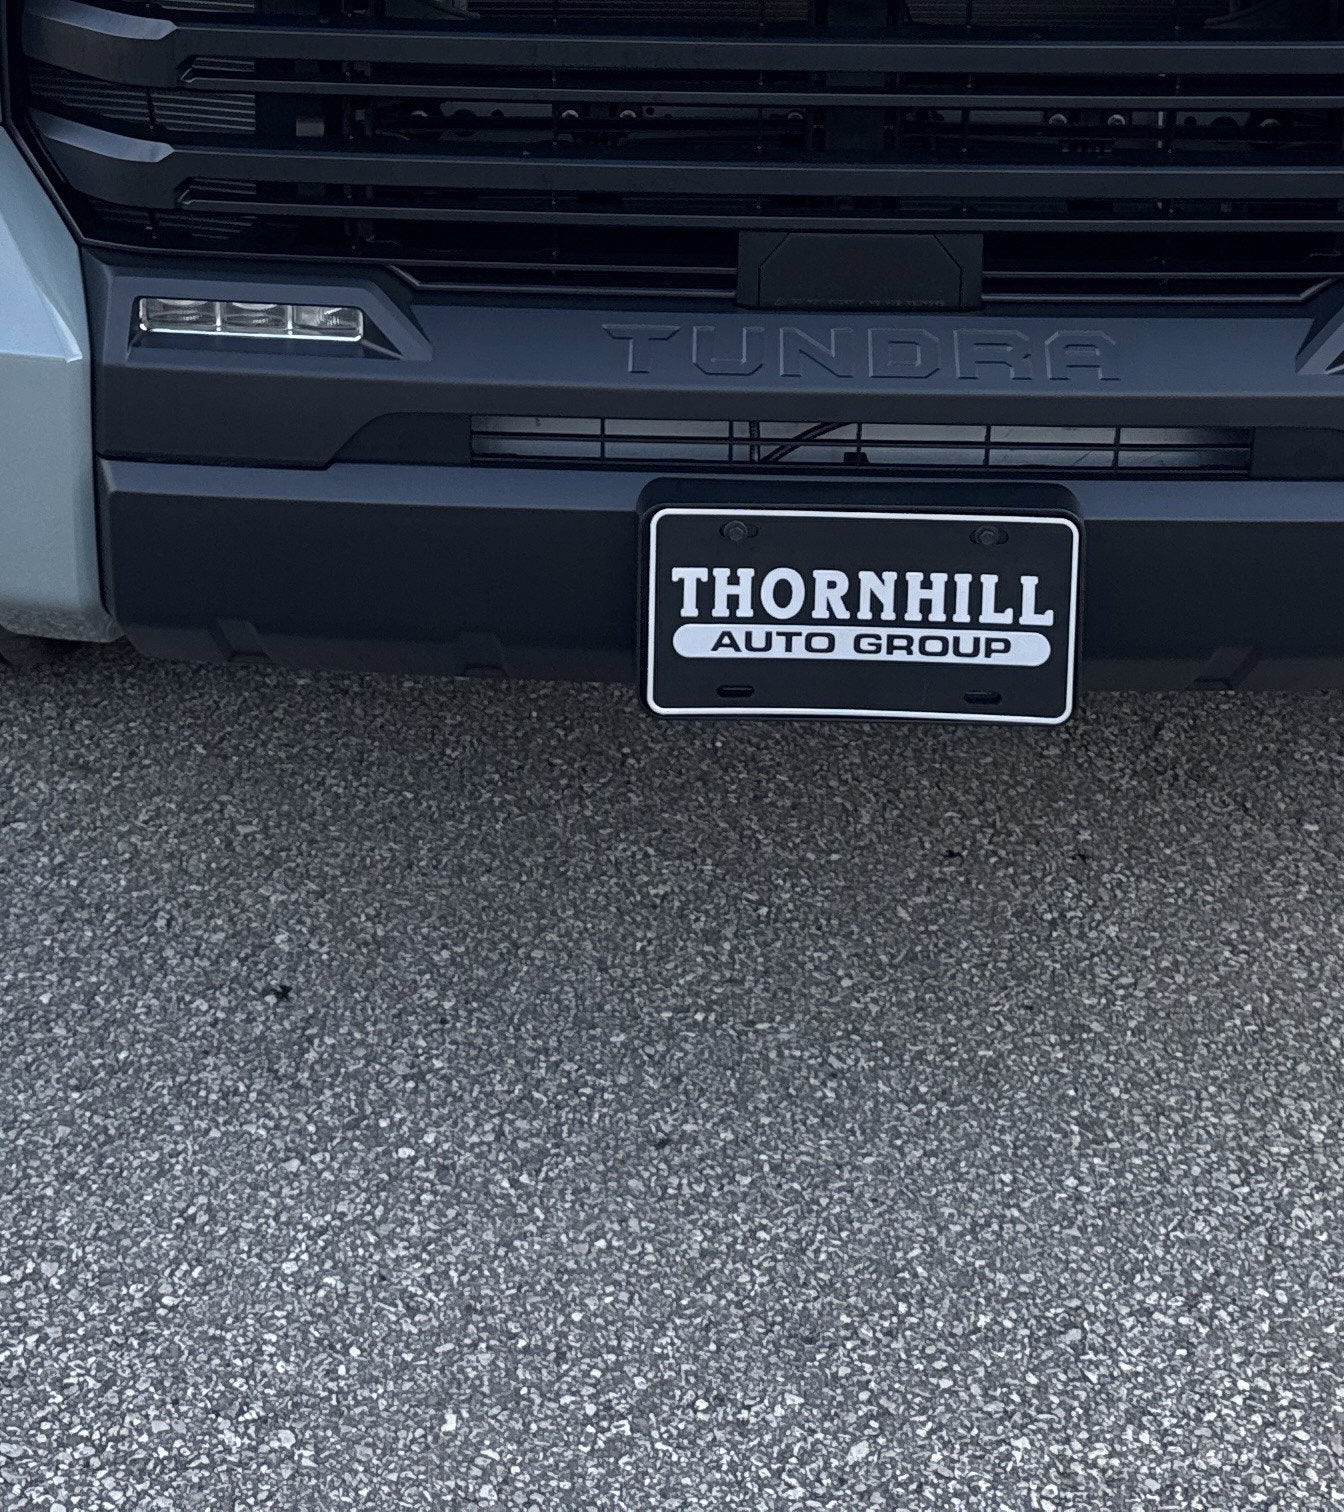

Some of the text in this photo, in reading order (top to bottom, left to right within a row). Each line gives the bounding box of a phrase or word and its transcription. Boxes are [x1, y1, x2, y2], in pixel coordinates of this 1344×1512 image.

[602, 324, 1121, 381] TUNDRA
[671, 567, 1054, 626] THORNHILL
[711, 630, 1012, 659] AUTO GROUP
